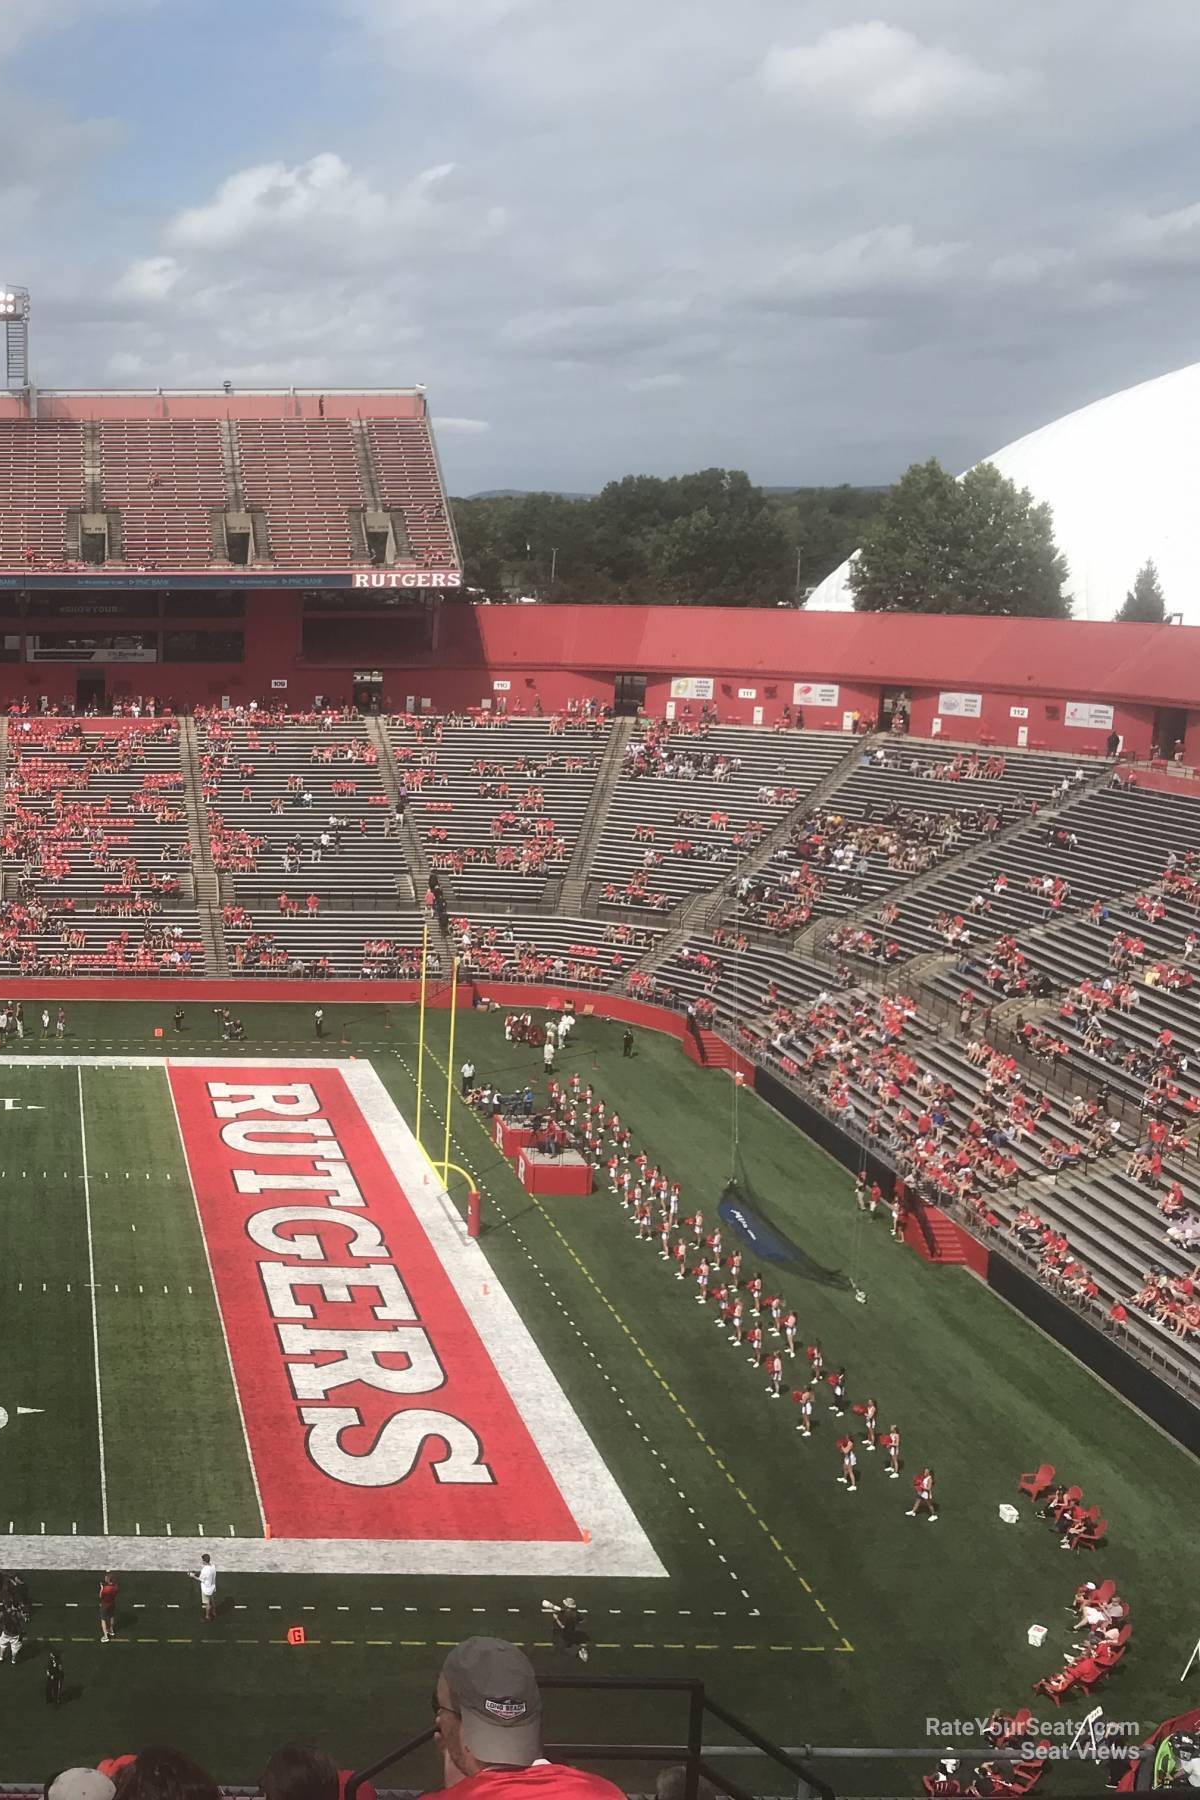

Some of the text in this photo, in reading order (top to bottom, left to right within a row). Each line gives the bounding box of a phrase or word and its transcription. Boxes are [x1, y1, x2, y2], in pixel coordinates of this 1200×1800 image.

[355, 573, 461, 588] RUTGERS
[206, 1081, 498, 1489] RUTGERS
[486, 1702, 504, 1710] LONG
